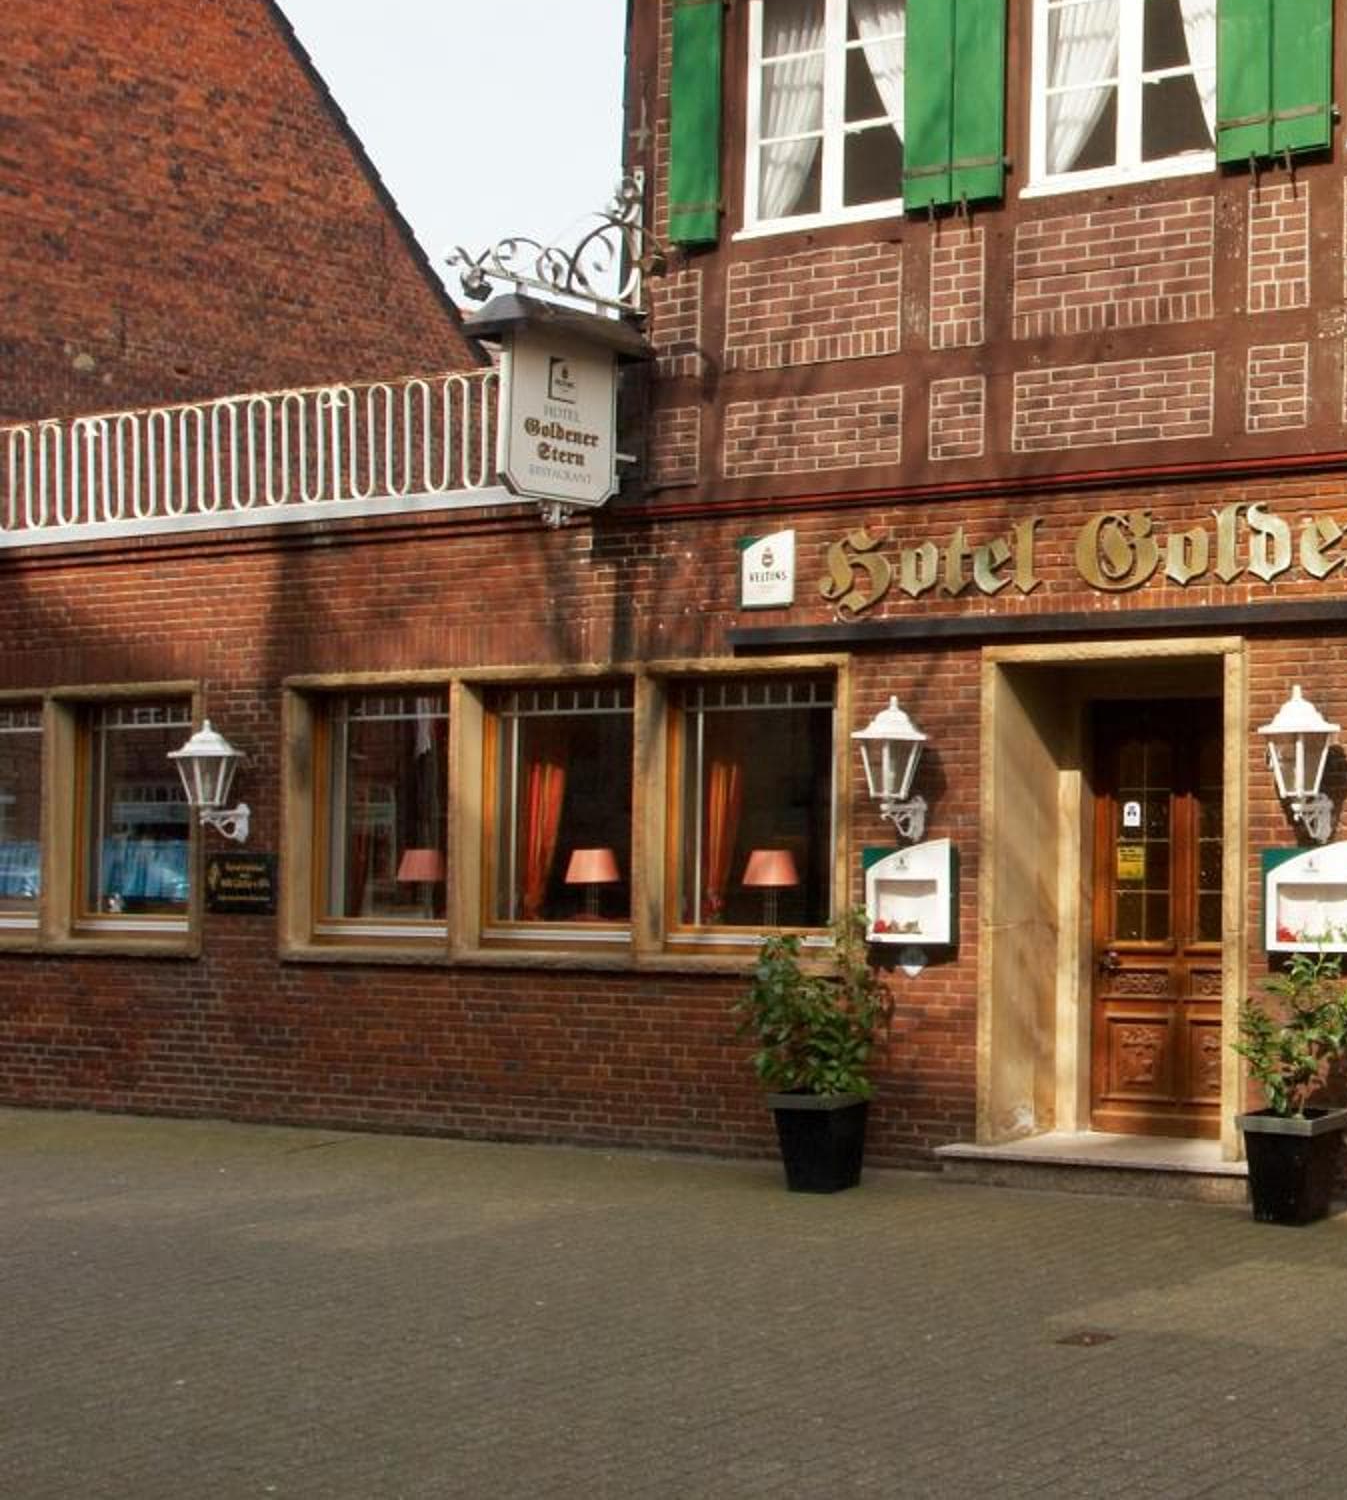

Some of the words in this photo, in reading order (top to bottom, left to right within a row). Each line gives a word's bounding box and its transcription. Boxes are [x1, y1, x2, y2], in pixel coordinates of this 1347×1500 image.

[524, 416, 599, 447] Goldener
[537, 442, 585, 466] Stern
[820, 516, 1045, 622] Hotel
